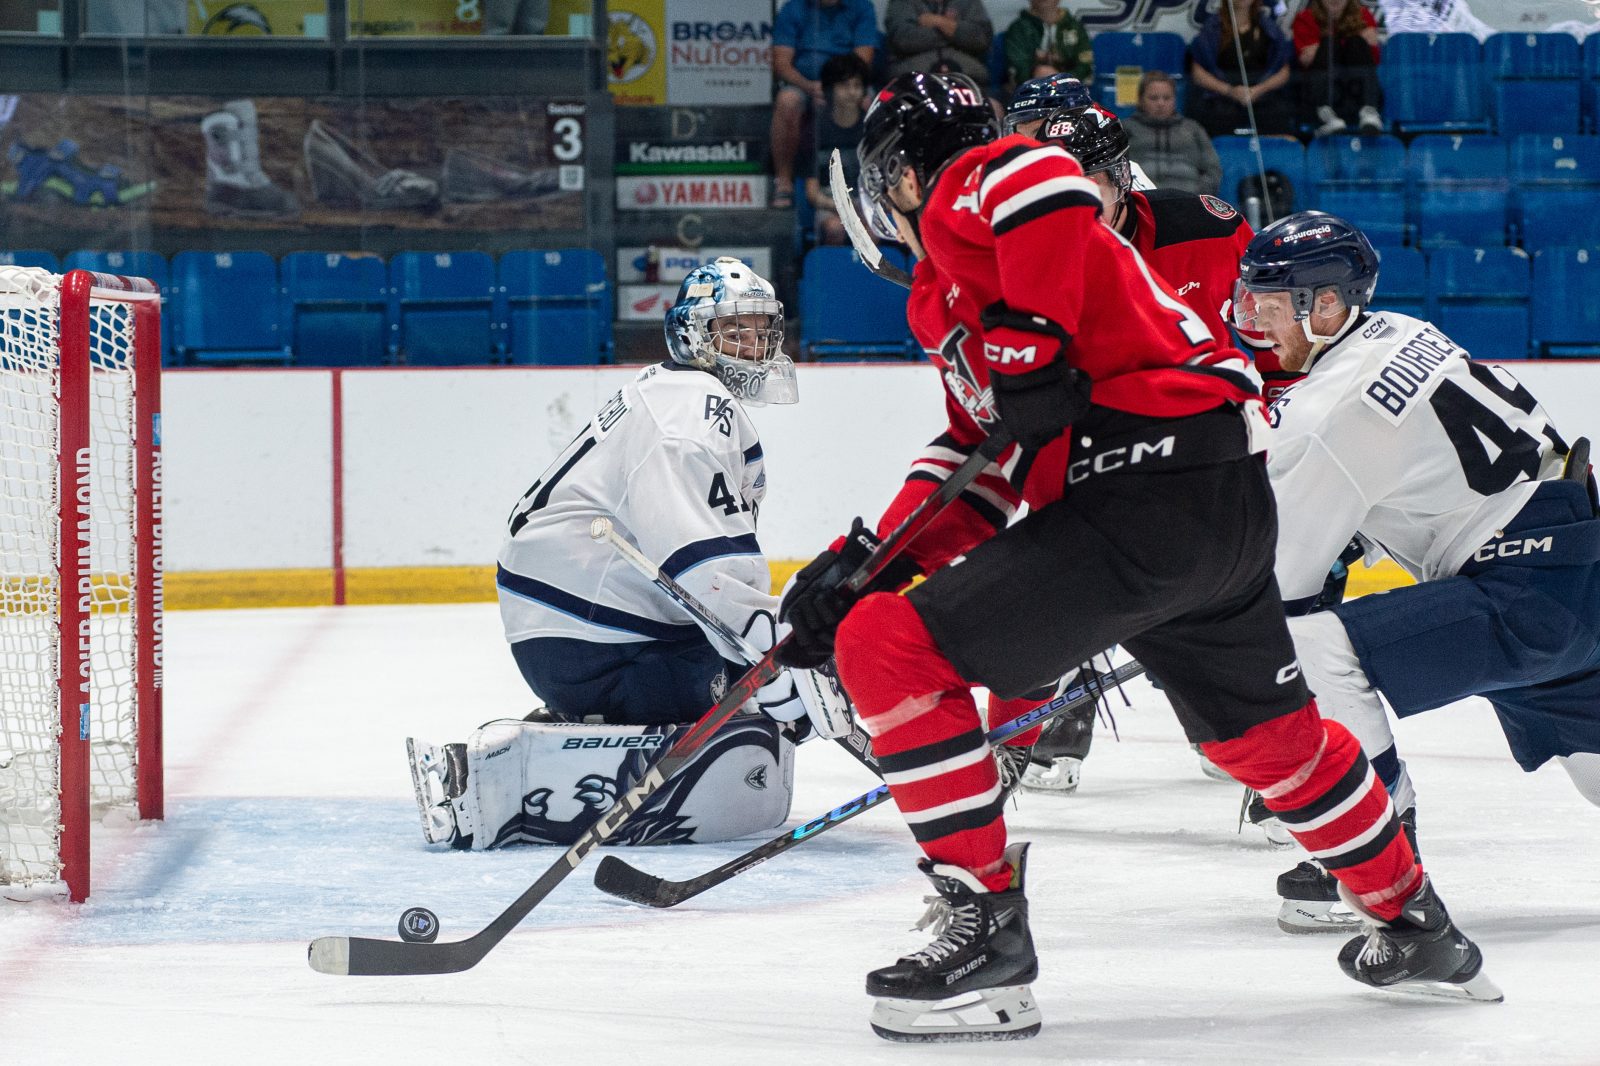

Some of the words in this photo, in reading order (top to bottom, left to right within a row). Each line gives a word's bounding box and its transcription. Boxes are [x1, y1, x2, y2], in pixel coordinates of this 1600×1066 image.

[1014, 98, 1037, 109] CCM
[671, 108, 698, 140] D
[1050, 121, 1073, 136] 88
[553, 118, 583, 161] 3
[1452, 136, 1463, 151] 7
[629, 141, 747, 162] Kawasaki
[661, 181, 753, 204] YAMAHA
[677, 213, 704, 248] C
[1474, 249, 1486, 263] 7
[1175, 281, 1201, 297] CM
[1362, 317, 1387, 340] CCM
[983, 341, 1037, 364] CM
[1366, 327, 1461, 417] BOURDEA
[1067, 435, 1176, 485] CCM
[1474, 536, 1553, 562] CCM
[742, 655, 779, 699] JET
[484, 745, 512, 760] MACH
[561, 735, 665, 750] BAUER
[566, 767, 665, 868] CCM
[946, 953, 987, 986] BAUER
